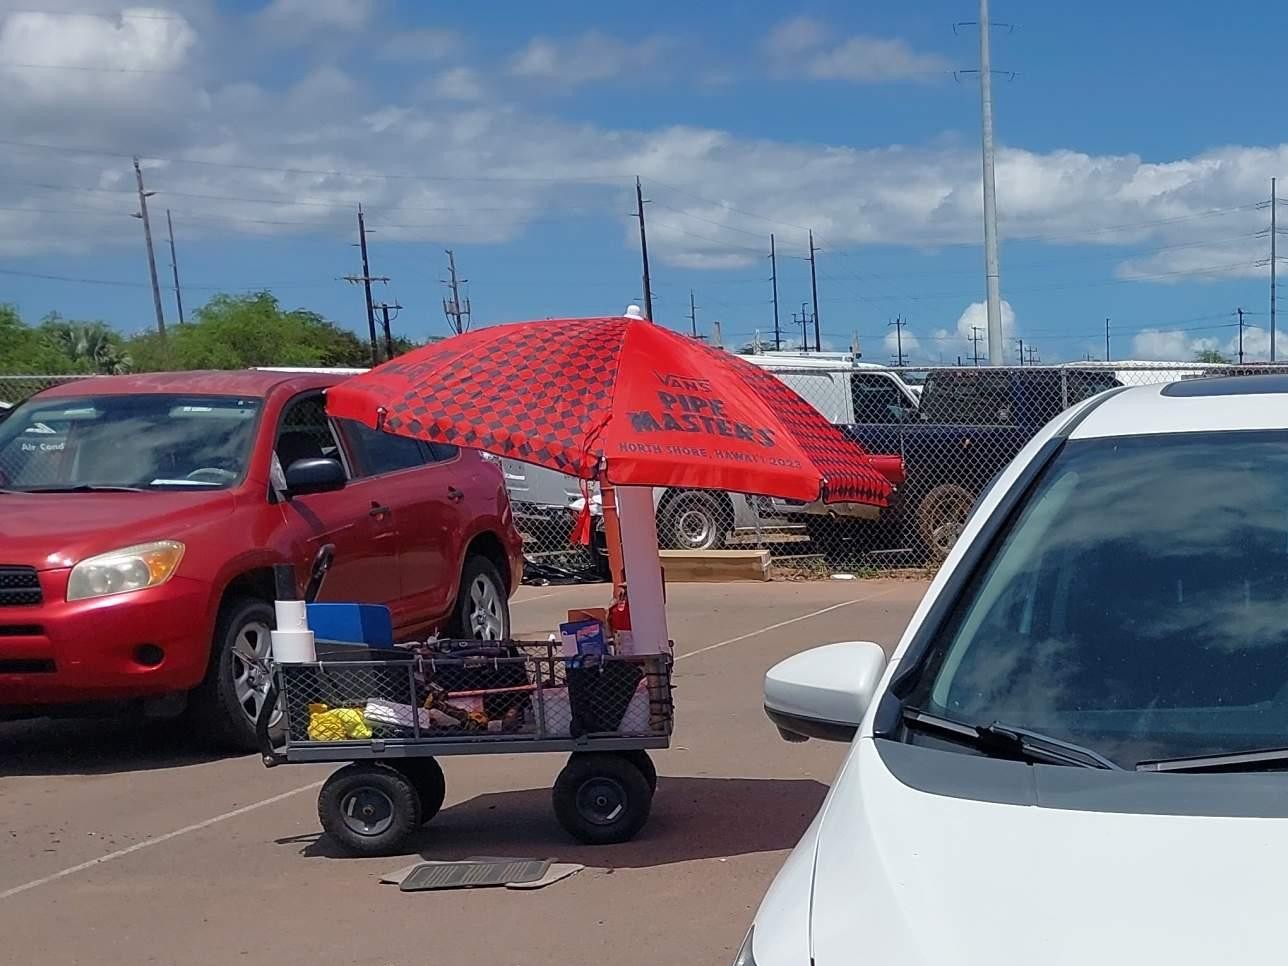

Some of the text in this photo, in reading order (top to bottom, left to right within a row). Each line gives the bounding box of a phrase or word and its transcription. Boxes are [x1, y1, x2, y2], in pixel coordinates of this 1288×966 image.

[653, 370, 712, 392] VANS
[657, 391, 727, 417] PIPE
[627, 411, 776, 447] MASTERS
[618, 442, 662, 454] NORTH
